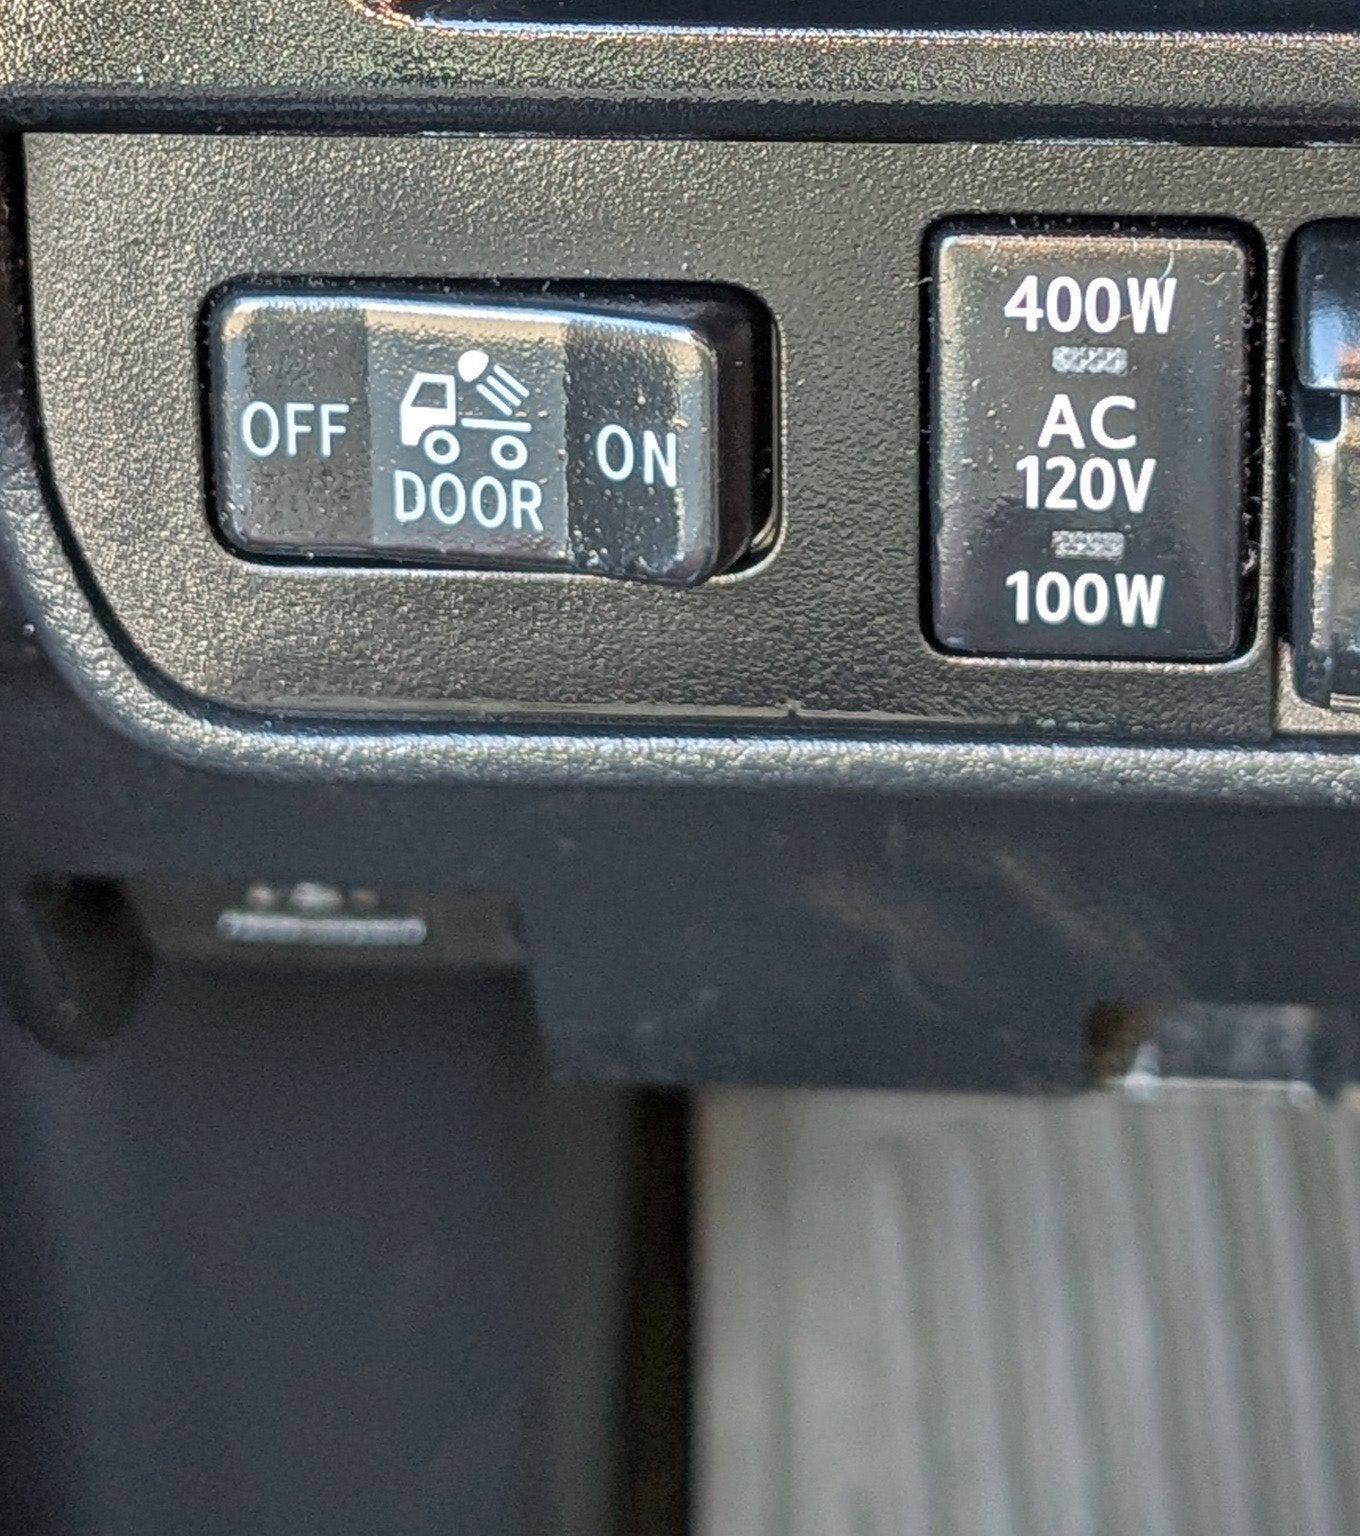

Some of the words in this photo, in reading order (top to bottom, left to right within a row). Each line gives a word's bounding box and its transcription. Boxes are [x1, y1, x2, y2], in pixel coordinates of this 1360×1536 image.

[1004, 275, 1178, 334] 400W
[242, 401, 350, 458] OFF
[1037, 393, 1137, 450] AC
[595, 423, 679, 488] ON
[1015, 455, 1157, 513] 120V
[393, 469, 544, 531] DOOR
[1005, 570, 1166, 628] 100W
